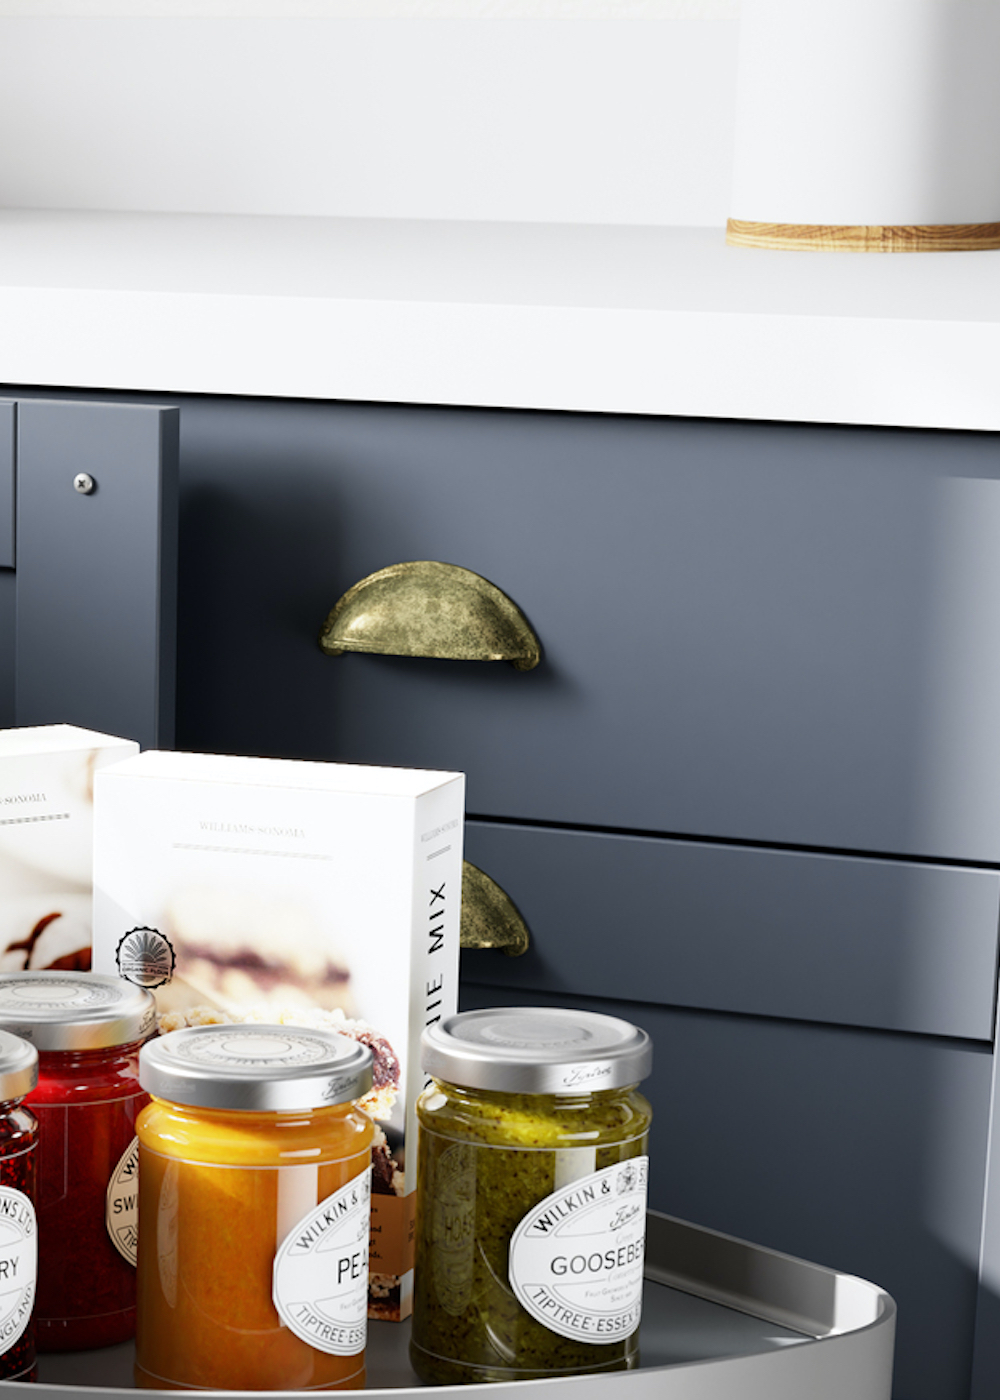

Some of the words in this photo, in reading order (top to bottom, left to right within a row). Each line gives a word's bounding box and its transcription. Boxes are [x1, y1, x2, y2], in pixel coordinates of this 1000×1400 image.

[428, 882, 446, 954] MIX
[296, 1198, 348, 1250] WILKIN
[533, 1186, 596, 1233] WILKIN
[600, 1178, 611, 1195] &
[550, 1237, 645, 1275] GOOSEBE
[296, 1304, 344, 1343] TIPTREE
[532, 1287, 592, 1331] TIPTREE
[596, 1312, 634, 1333] ESSEX
